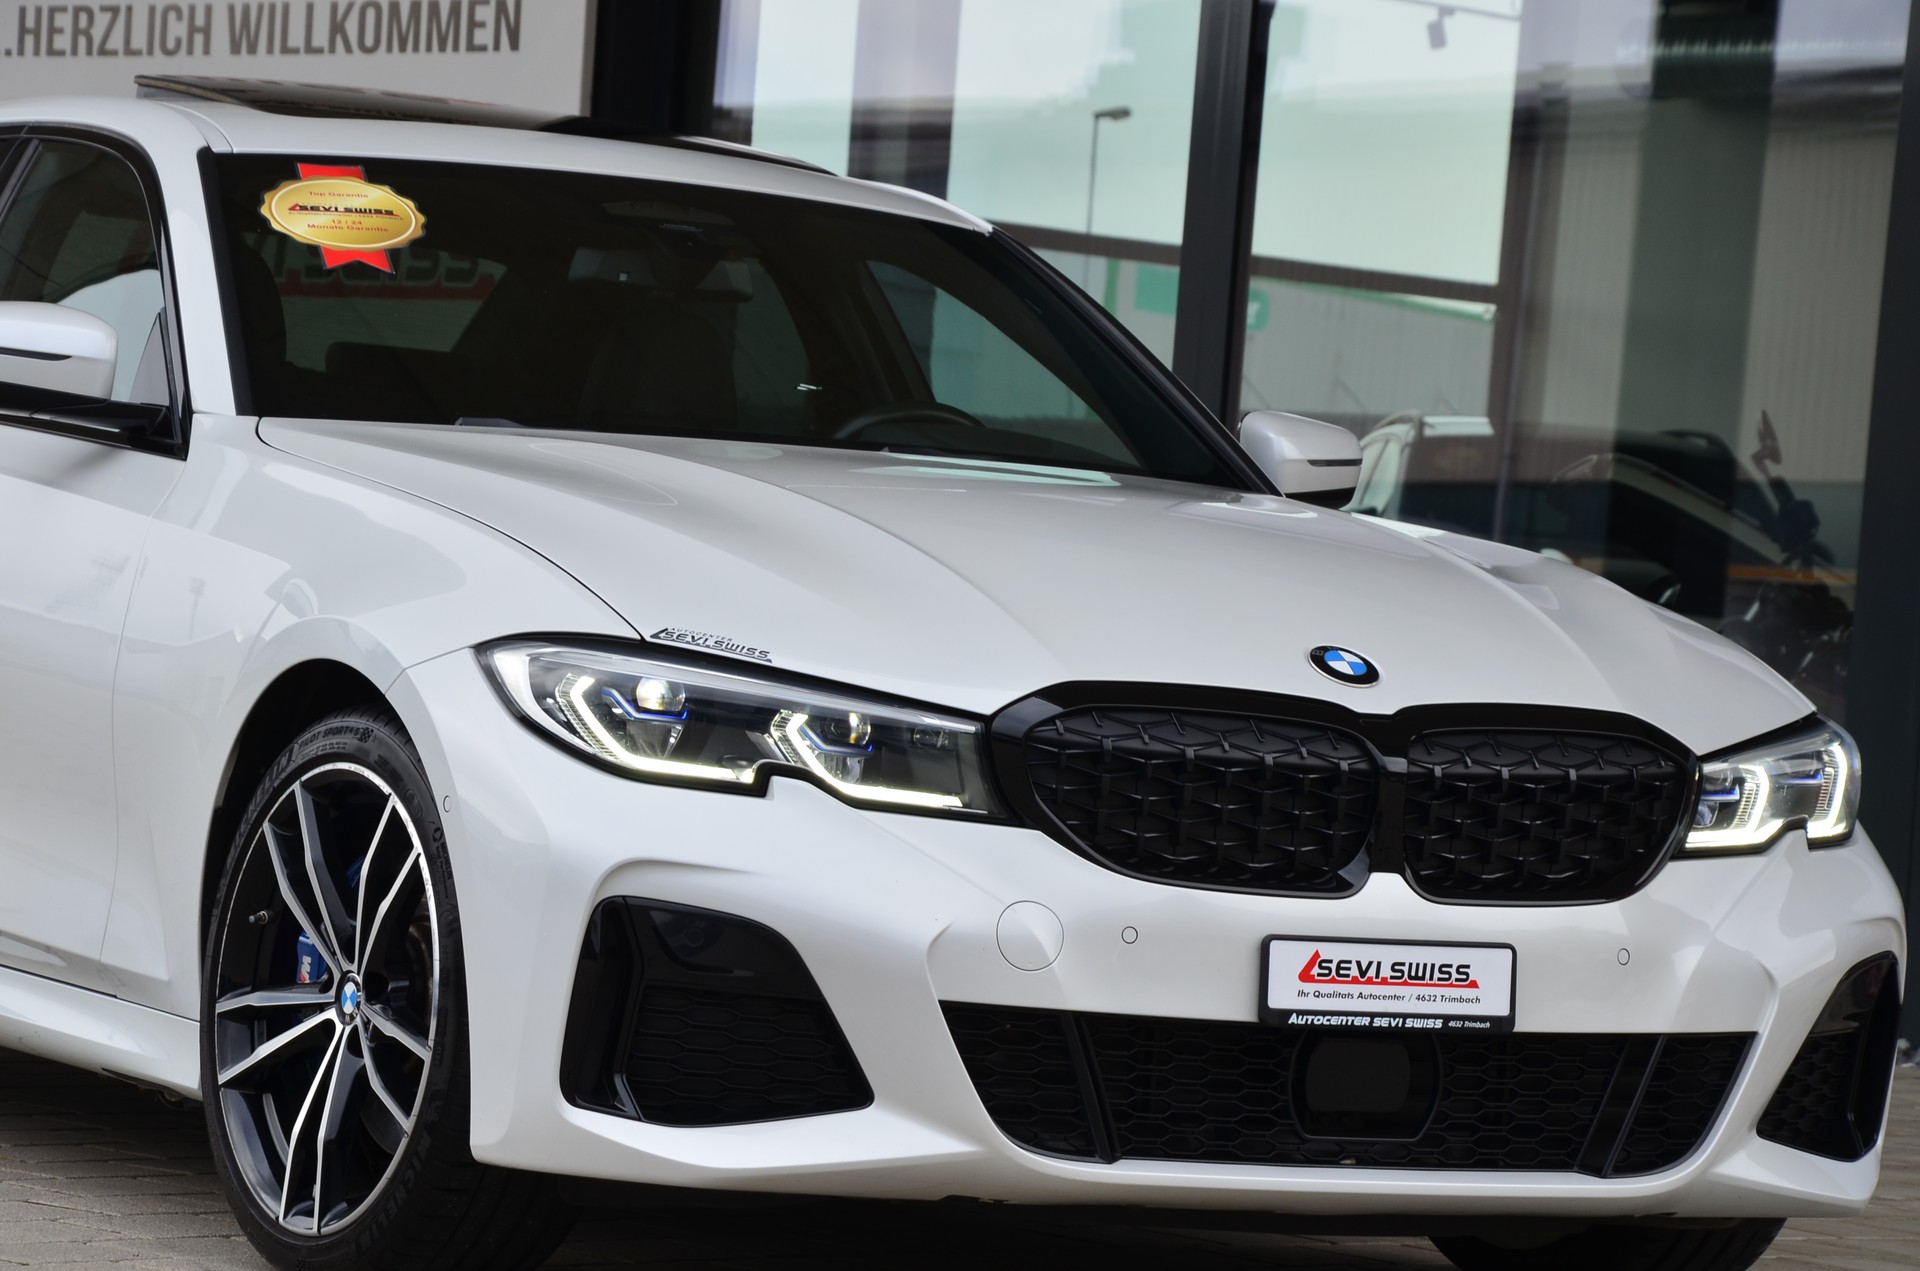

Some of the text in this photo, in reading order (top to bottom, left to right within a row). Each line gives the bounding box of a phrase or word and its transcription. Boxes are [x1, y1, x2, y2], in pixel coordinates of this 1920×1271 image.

[227, 0, 521, 55] WILLKOMMEN
[298, 204, 340, 213] SEVI
[343, 206, 394, 216] SWISS
[670, 627, 733, 642] AUTOCENTER
[662, 631, 771, 659] SEVI SWISS
[1316, 958, 1471, 983] SEVI SWISS
[1297, 989, 1310, 998] Ihr
[1357, 991, 1406, 1002] Autocenter
[1415, 993, 1437, 1003] 4632
[1439, 994, 1481, 1004] Trimbach
[1372, 1016, 1403, 1028] SEVI
[1404, 1018, 1443, 1028] SWISS
[1463, 1020, 1491, 1029] Trimbach
